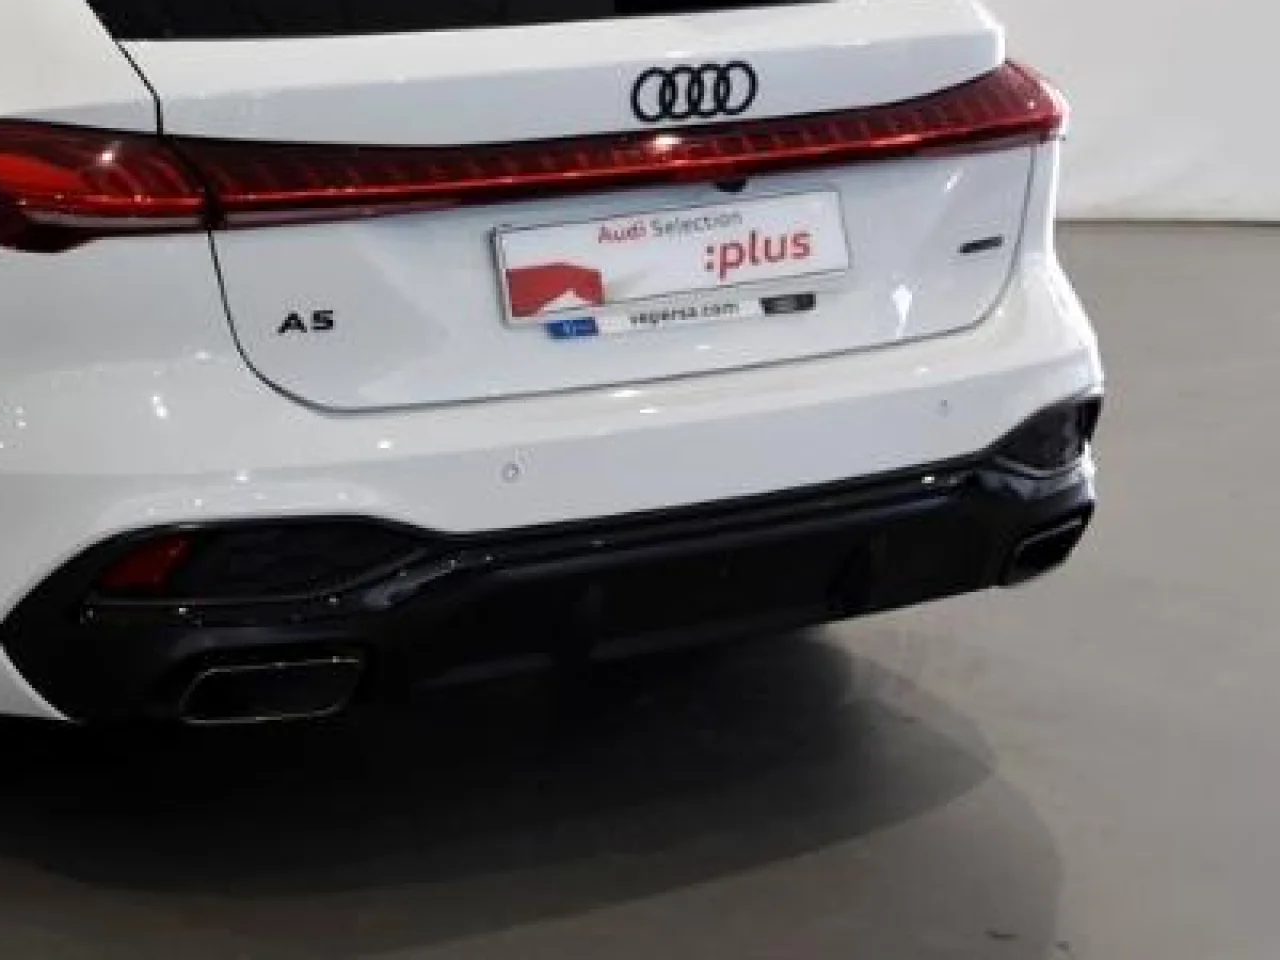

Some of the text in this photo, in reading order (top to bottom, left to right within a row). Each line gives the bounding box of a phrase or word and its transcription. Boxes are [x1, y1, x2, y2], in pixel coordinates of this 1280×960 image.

[597, 212, 742, 244] Audi Selection
[704, 228, 811, 281] :plus
[277, 309, 335, 334] A5
